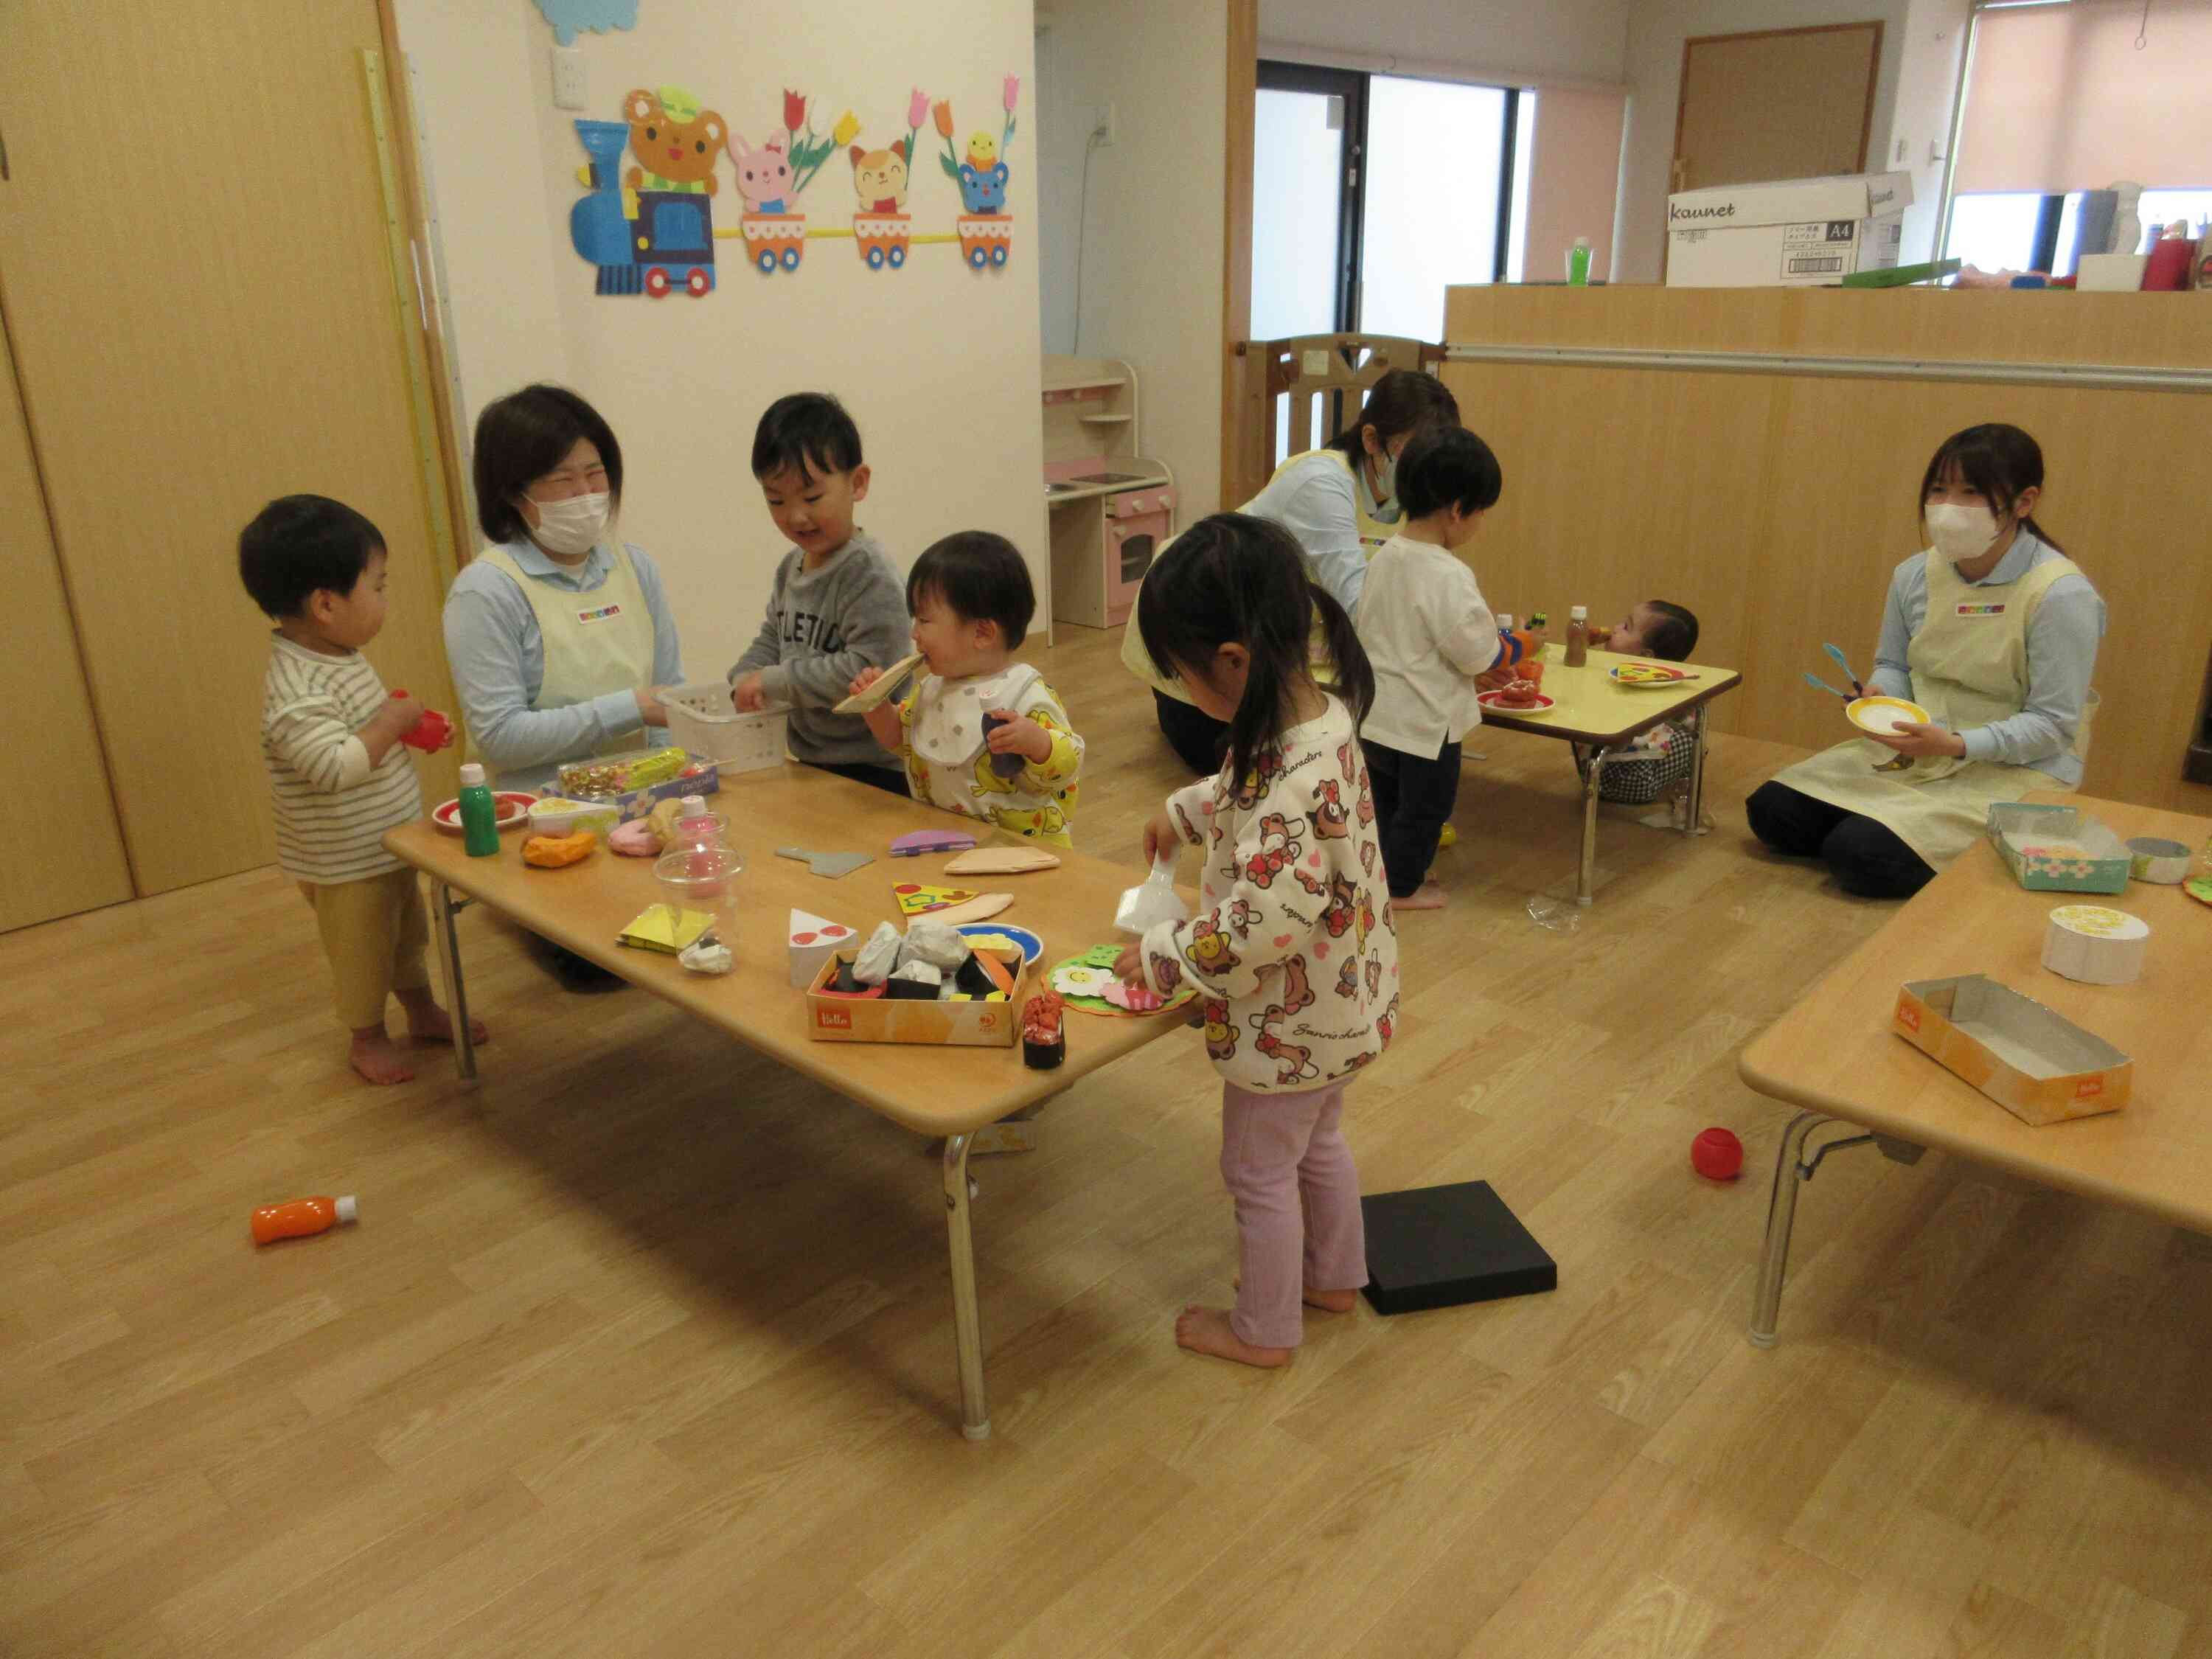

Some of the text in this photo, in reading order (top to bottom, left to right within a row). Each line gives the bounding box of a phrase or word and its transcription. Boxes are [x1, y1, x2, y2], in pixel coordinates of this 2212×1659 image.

[1669, 202, 1736, 223] kaunet
[1830, 223, 1850, 237] A4
[1279, 751, 1322, 782] characters
